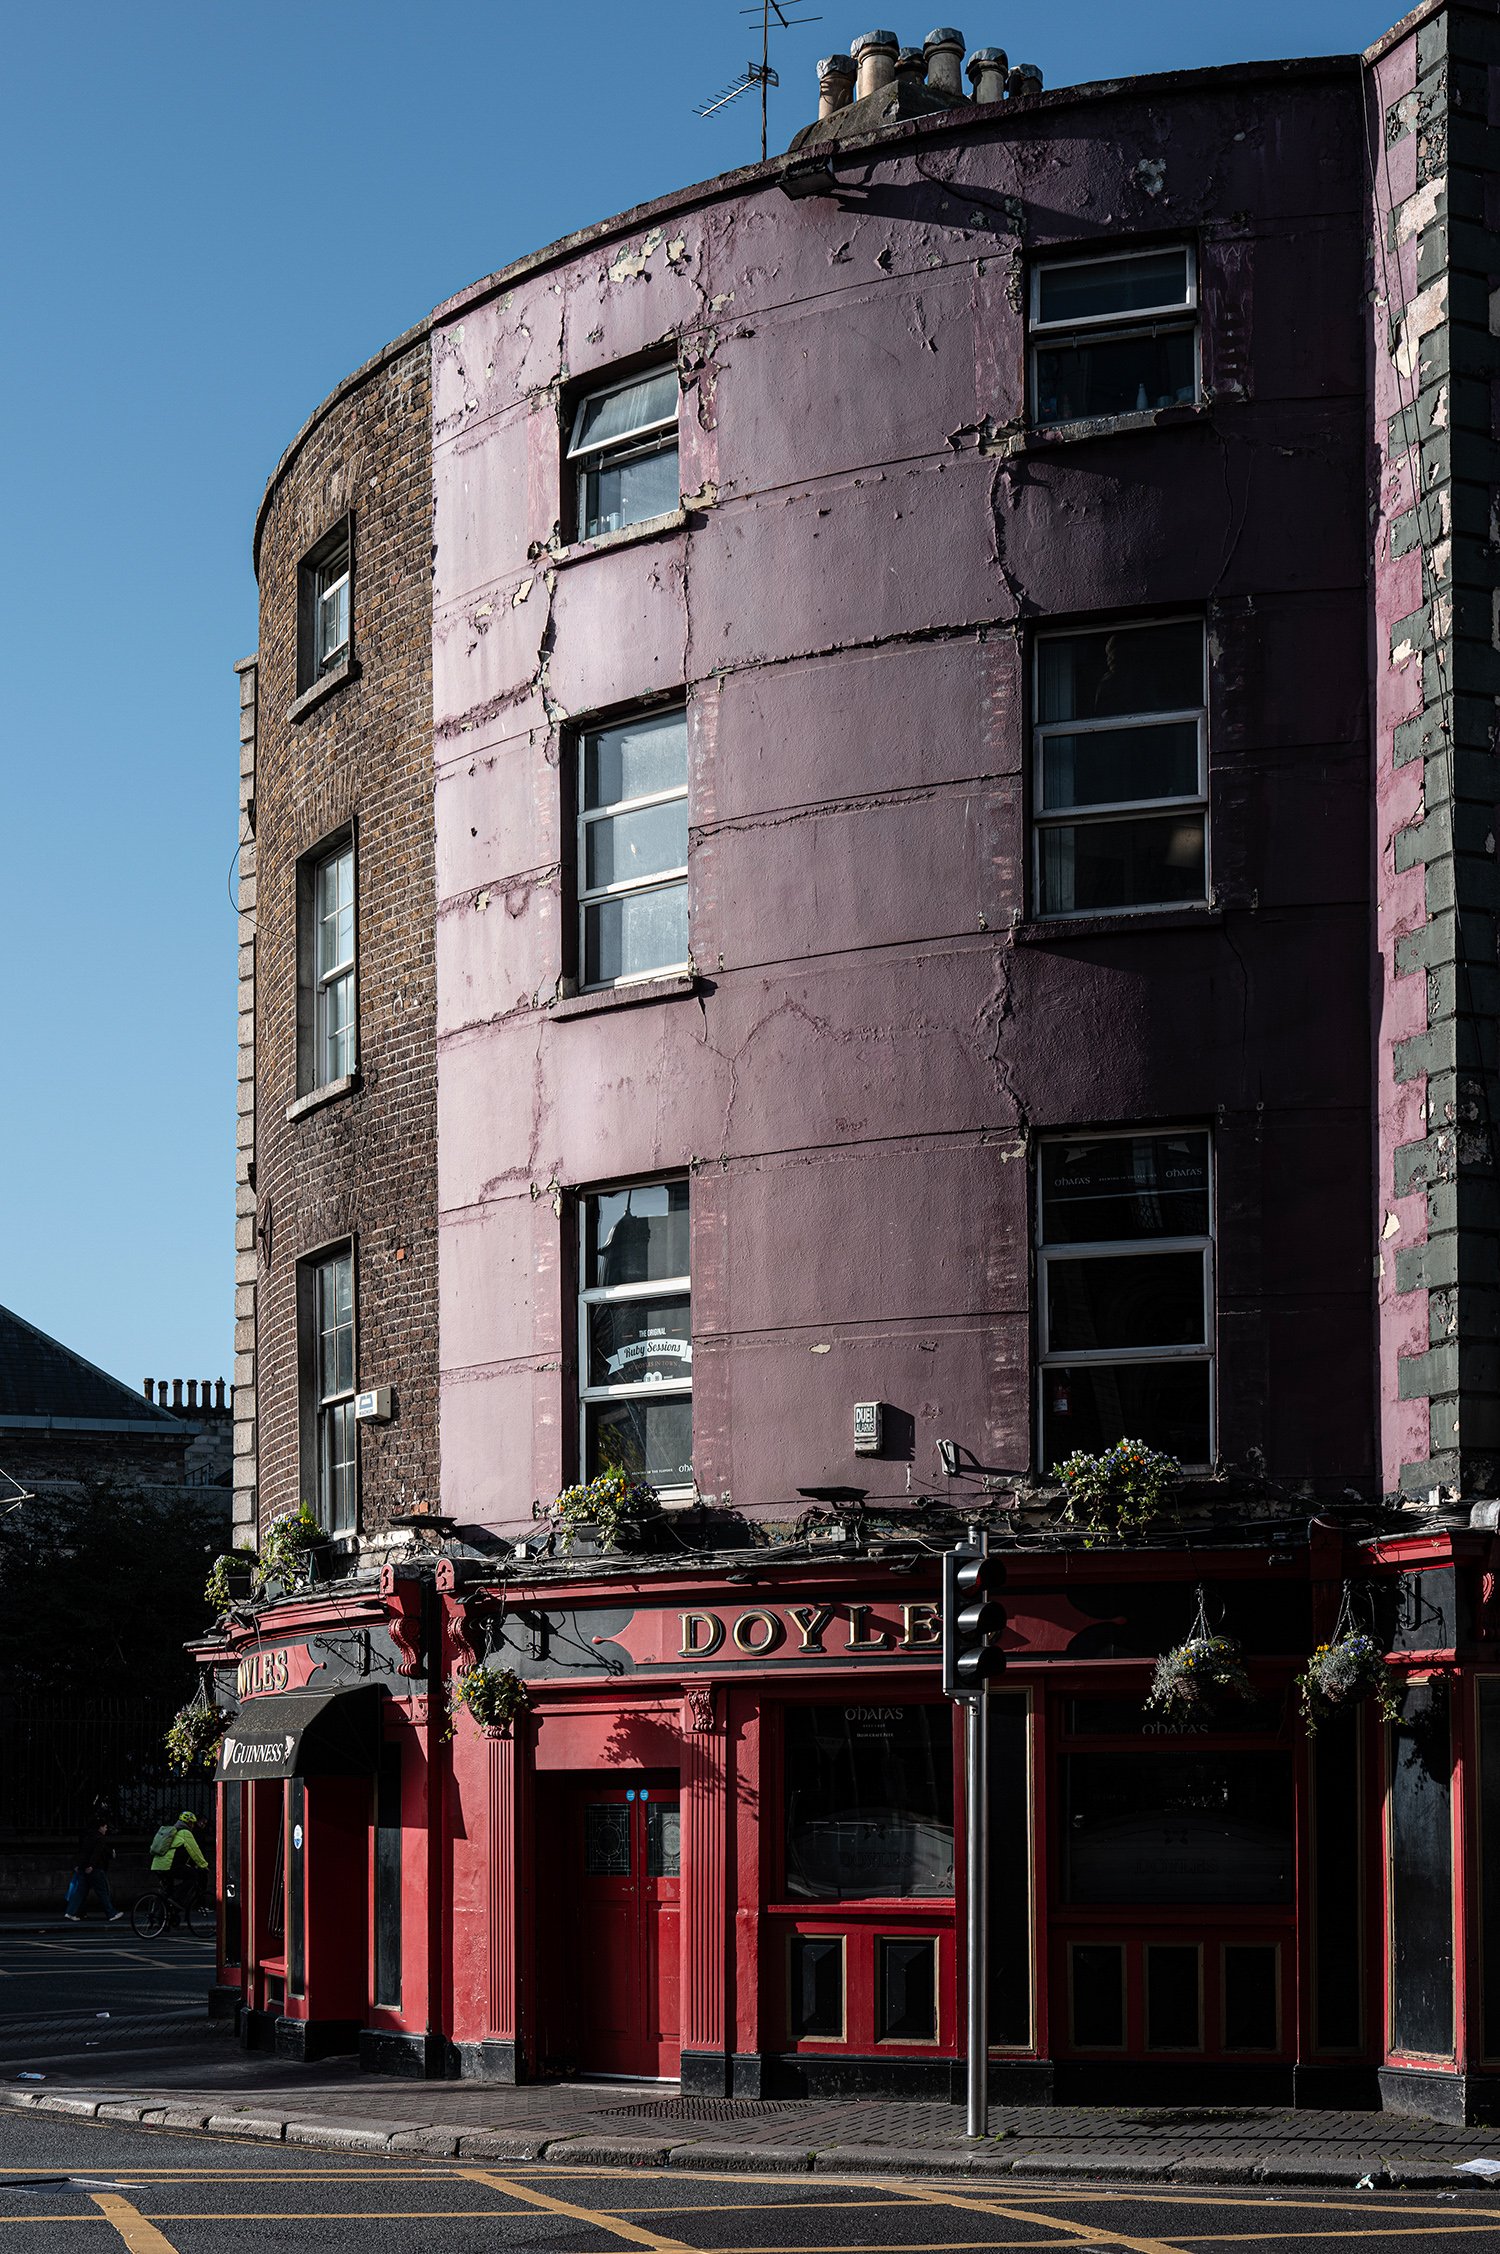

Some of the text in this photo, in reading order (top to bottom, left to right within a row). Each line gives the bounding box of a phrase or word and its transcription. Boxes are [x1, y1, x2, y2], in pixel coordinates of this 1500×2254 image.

[624, 1341, 681, 1359] Ruby Sessions
[856, 1407, 873, 1423] DUEL
[856, 1423, 875, 1432] ALARMS
[232, 1742, 284, 1764] GUINNESS
